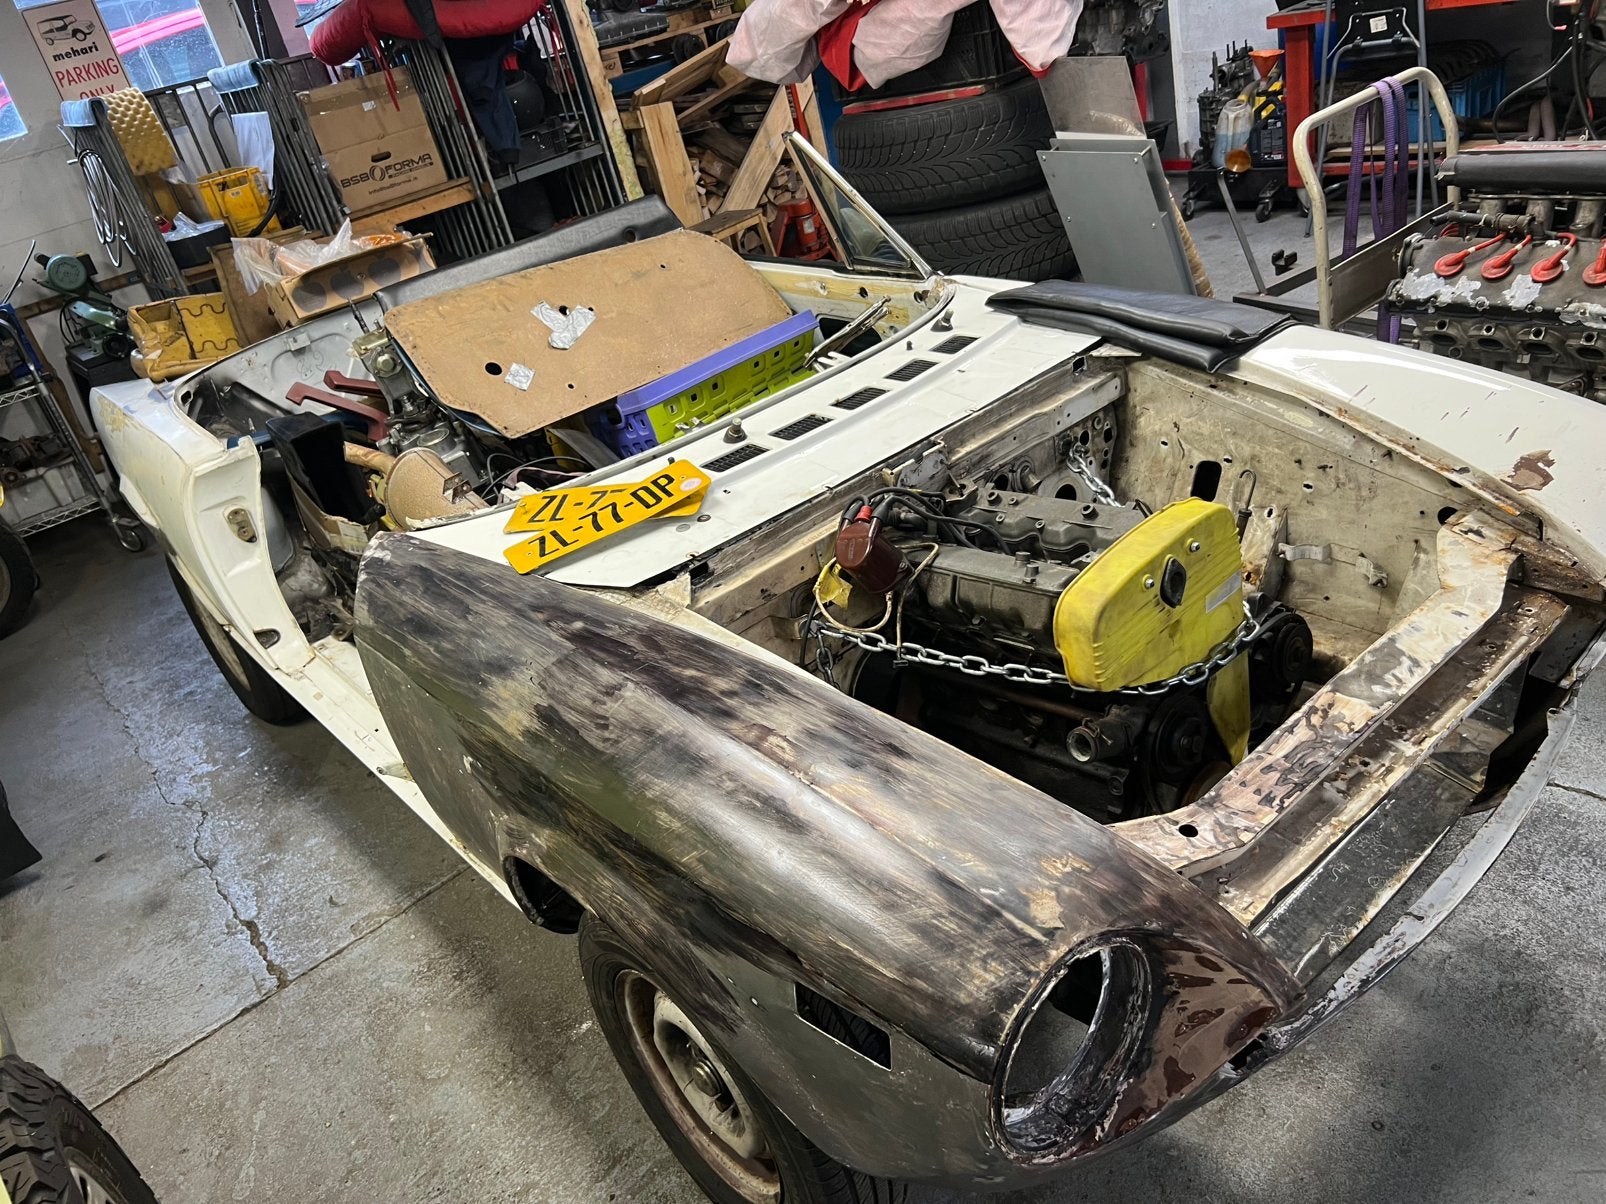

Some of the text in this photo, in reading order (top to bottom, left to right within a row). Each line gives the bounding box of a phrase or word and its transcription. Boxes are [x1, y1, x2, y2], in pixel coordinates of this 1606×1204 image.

[52, 42, 99, 61] mehari
[55, 58, 119, 88] PARKING
[528, 473, 675, 558] ZL-77-DP
